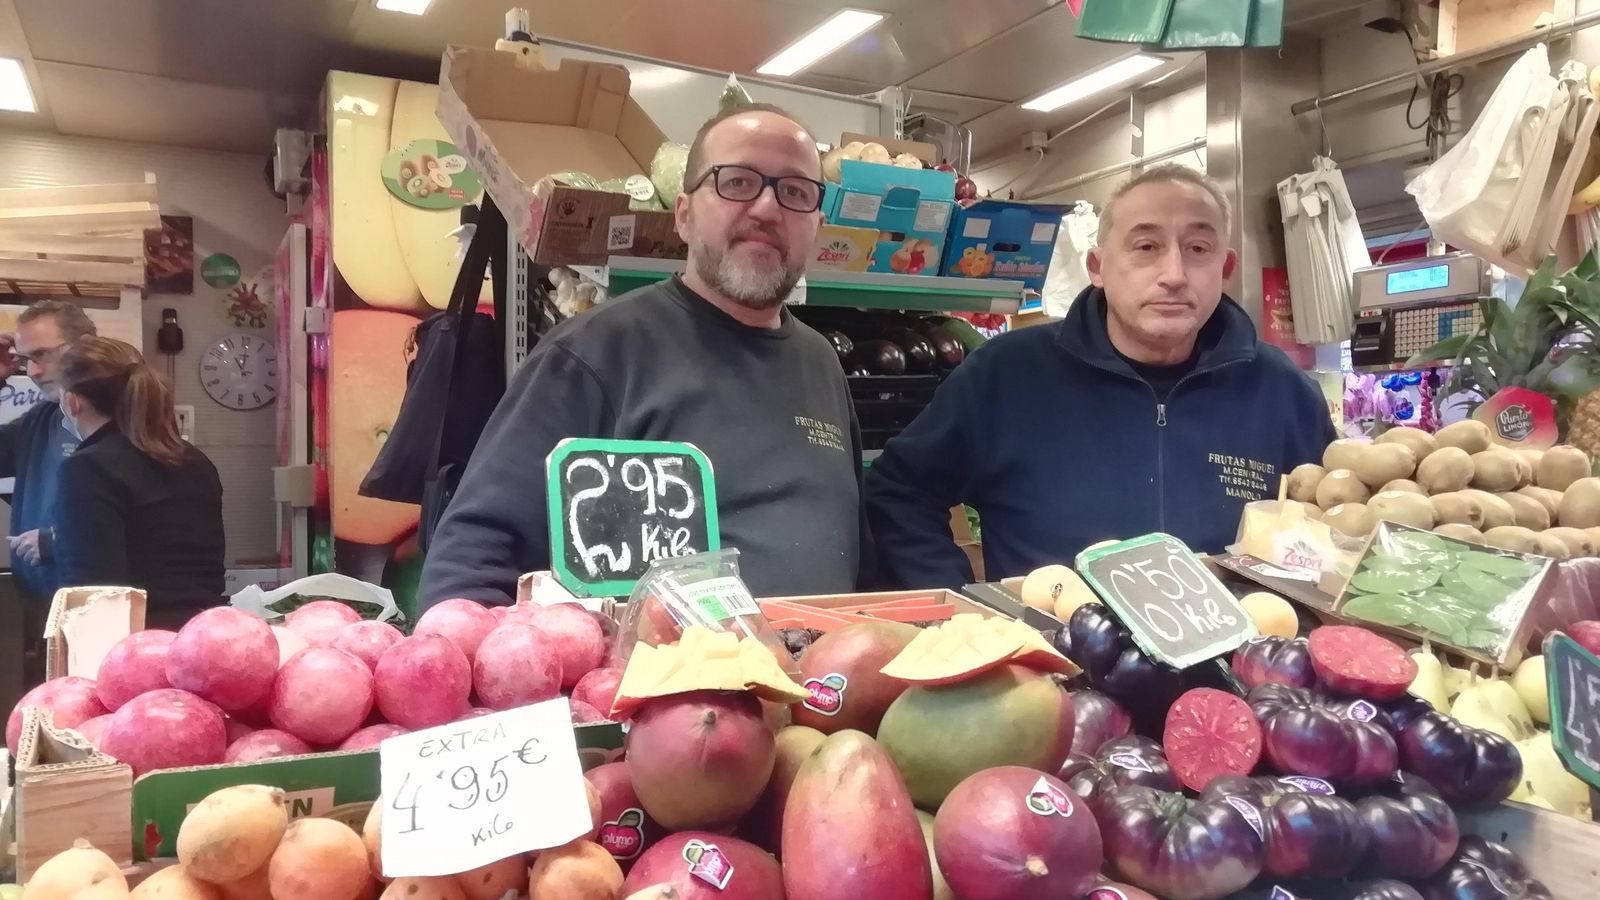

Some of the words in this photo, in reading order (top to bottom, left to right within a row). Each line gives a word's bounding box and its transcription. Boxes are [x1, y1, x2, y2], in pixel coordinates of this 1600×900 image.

[794, 416, 823, 430] FRUTAS
[1500, 409, 1529, 425] Puerto
[1208, 453, 1246, 468] FRUTAS
[1248, 459, 1275, 474] MIGUEL
[566, 454, 695, 578] 2'95
[1283, 546, 1323, 569] Zespri
[418, 722, 507, 758] EXTRA
